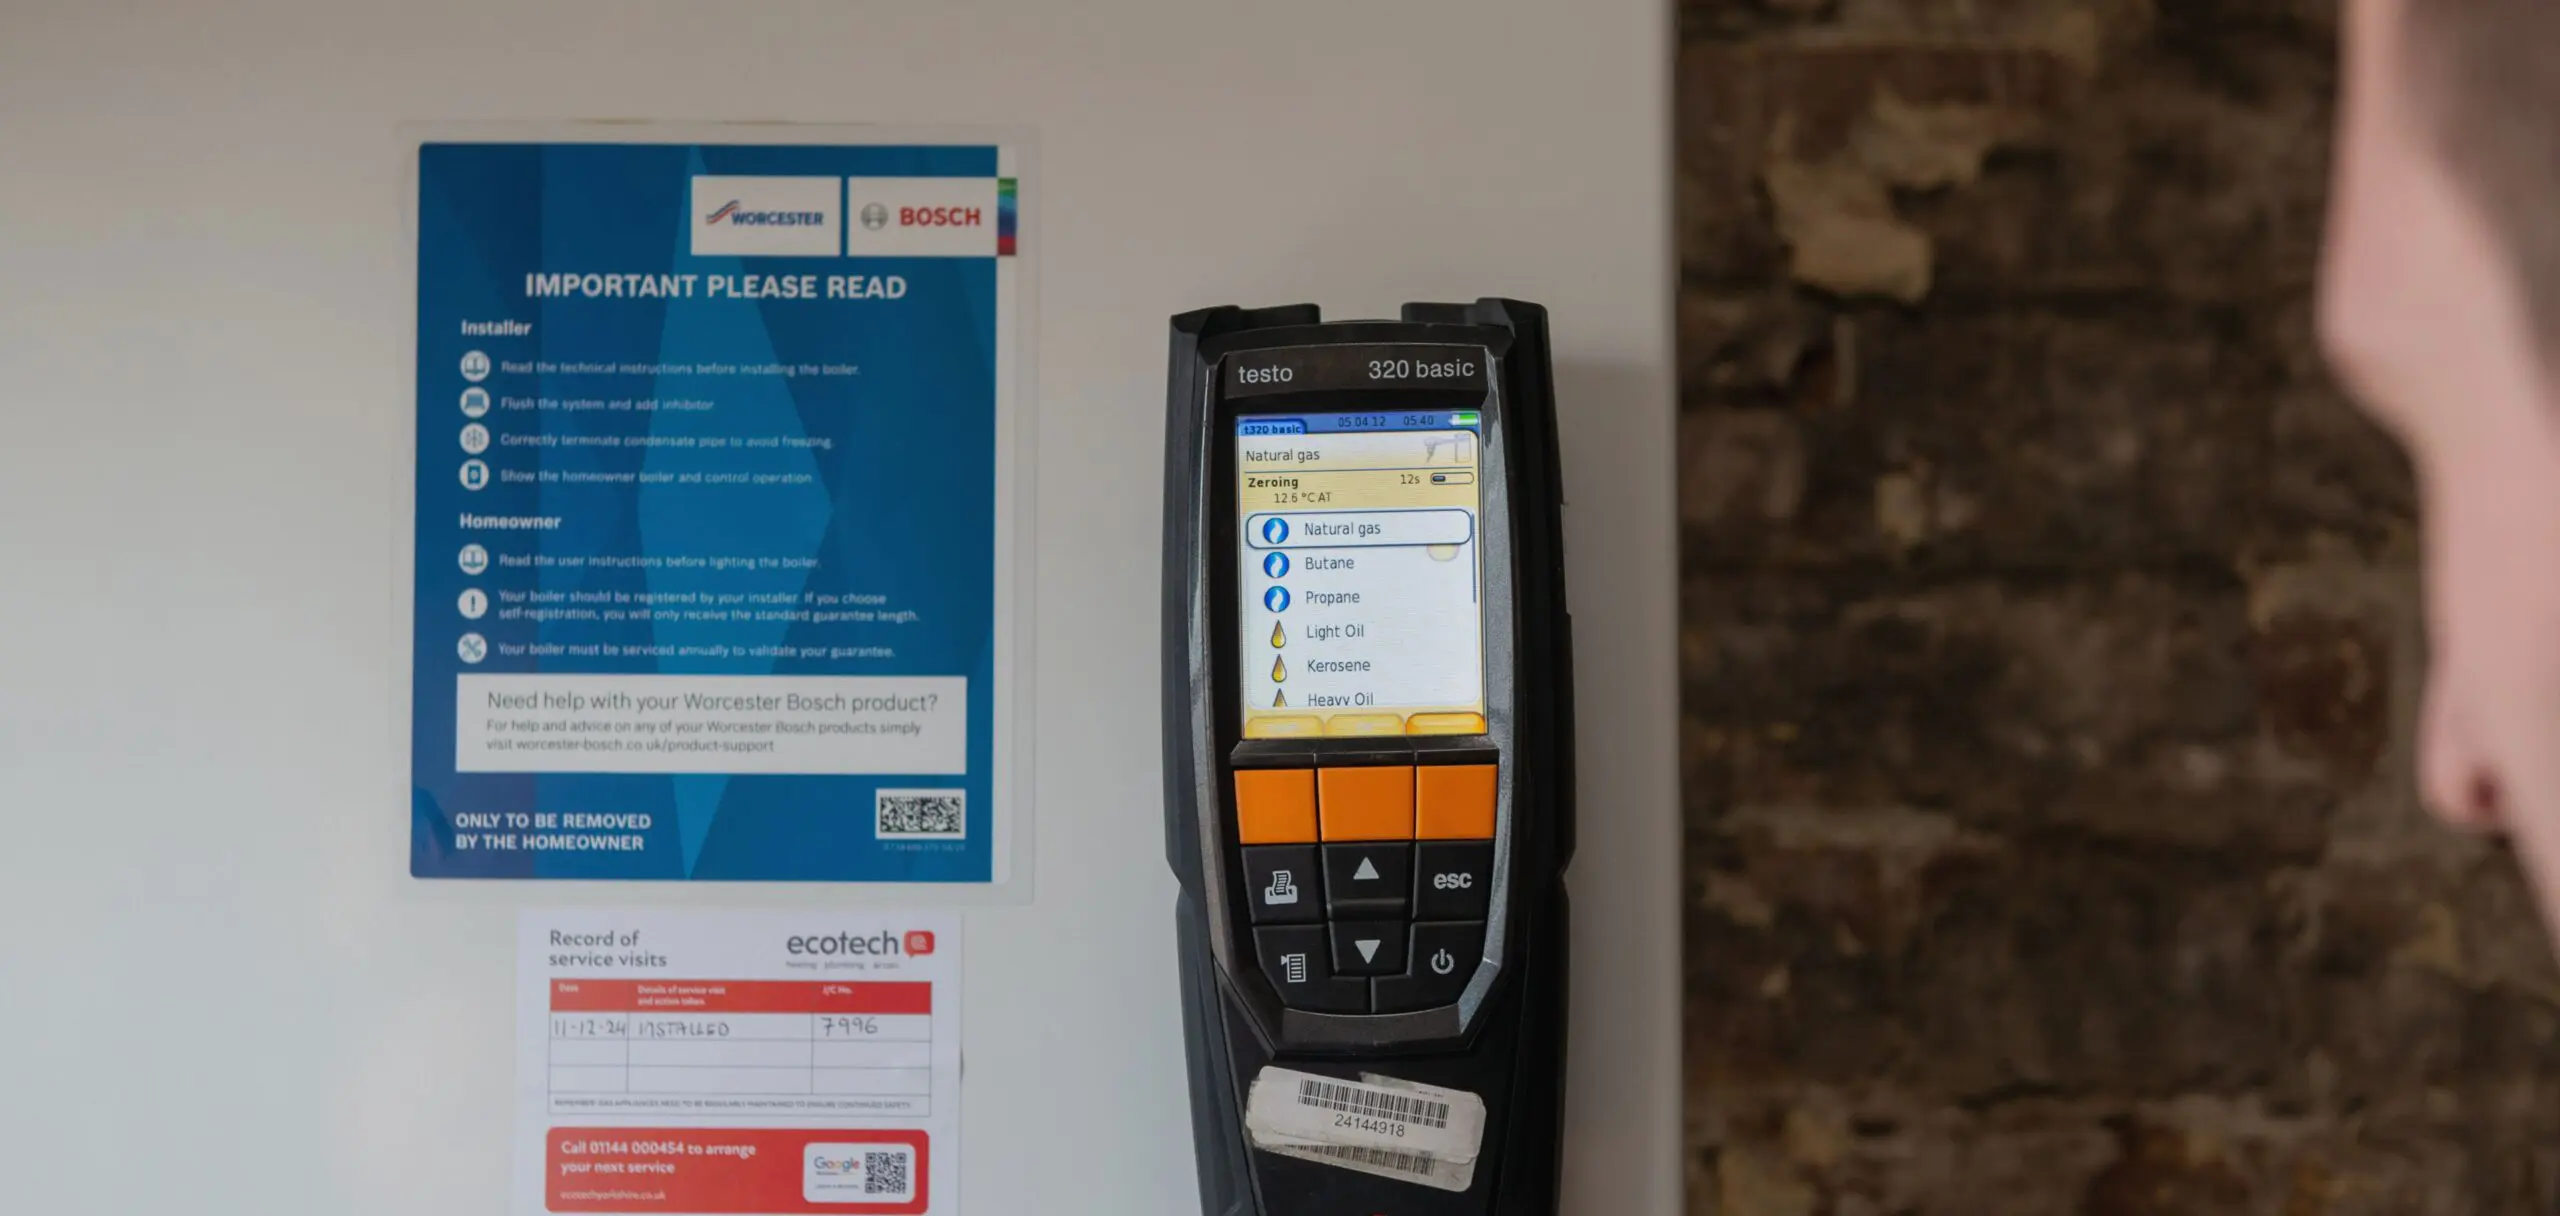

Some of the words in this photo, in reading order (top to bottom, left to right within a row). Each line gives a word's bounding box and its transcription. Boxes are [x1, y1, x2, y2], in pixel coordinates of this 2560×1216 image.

[732, 209, 824, 226] WORCESTER
[900, 208, 981, 226] BOSCH
[525, 272, 698, 298] IMPORTANT
[707, 274, 817, 298] PLEASE
[826, 276, 906, 298] READ
[462, 319, 532, 336] Installer
[502, 361, 532, 373] Read
[537, 362, 556, 373] the
[561, 363, 615, 373] technical
[620, 363, 692, 374] instructions
[697, 363, 736, 374] before
[741, 364, 794, 376] installing
[800, 365, 818, 375] the
[823, 364, 860, 375] boiler.
[1238, 365, 1292, 383] testo
[1368, 360, 1409, 378] 320
[1416, 359, 1474, 378] basic
[501, 397, 533, 409] Flush
[538, 398, 558, 409] the
[563, 399, 604, 412] system
[609, 399, 631, 410] and
[636, 399, 658, 410] add
[1244, 426, 1269, 434] t320
[1272, 425, 1301, 434] basic
[501, 433, 557, 447] Correctly
[562, 434, 620, 446] terminate
[624, 436, 694, 447] condensate
[699, 437, 725, 448] pipe
[731, 437, 742, 446] to
[747, 436, 778, 447] avoid
[783, 436, 835, 449] freezing.
[1246, 450, 1293, 462] Natural
[1298, 451, 1320, 464] gas
[501, 469, 535, 481] Show
[539, 471, 557, 481] the
[563, 470, 634, 482] homeowner
[639, 470, 673, 483] boiler
[679, 471, 700, 483] and
[705, 473, 748, 483] control
[753, 473, 811, 484] operation
[1248, 476, 1298, 488] Zeroing
[1400, 474, 1420, 484] 12s
[1274, 493, 1298, 503] 12.6
[460, 512, 561, 529] Homeowner
[1304, 523, 1354, 535] Natural
[1359, 523, 1380, 537] gas
[500, 554, 530, 566] Read
[535, 555, 554, 566] the
[558, 557, 584, 566] user
[589, 556, 661, 567] instructions
[667, 556, 705, 567] before
[710, 557, 754, 569] lighting
[759, 558, 778, 567] the
[1305, 557, 1354, 570] Butane
[499, 590, 526, 602] Your
[530, 590, 565, 602] boiler
[570, 591, 610, 602] should
[615, 592, 629, 602] be
[634, 592, 695, 605] registered
[700, 593, 713, 605] by
[718, 595, 744, 604] your
[805, 592, 813, 603] If
[818, 595, 838, 605] you
[843, 593, 886, 604] choose
[1306, 591, 1360, 606] Propane
[604, 610, 624, 621] you
[629, 609, 650, 620] will
[655, 610, 679, 621] only
[684, 612, 726, 621] receive
[731, 610, 751, 620] the
[755, 610, 809, 621] standard
[813, 613, 873, 623] guarantee
[878, 611, 920, 623] length.
[1307, 625, 1342, 640] Light
[1345, 624, 1364, 638] Oil
[499, 643, 525, 654] Your
[530, 643, 565, 655] boiler
[569, 644, 598, 655] must
[604, 644, 618, 655] be
[623, 645, 674, 656] serviced
[678, 645, 728, 658] annually
[733, 646, 745, 656] to
[750, 645, 797, 656] validate
[801, 648, 827, 658] your
[831, 647, 895, 658] guarantee.
[1307, 660, 1370, 673] Kerosene
[488, 692, 537, 708] Need
[544, 692, 585, 711] help
[590, 692, 631, 709] with
[636, 696, 678, 713] your
[684, 693, 781, 711] Worcester
[787, 693, 845, 711] Bosch
[852, 693, 938, 714] product?
[1354, 692, 1373, 706] Oil
[487, 720, 507, 731] For
[512, 720, 539, 733] help
[543, 720, 566, 731] and
[570, 720, 611, 732] advice
[615, 723, 630, 732] on
[634, 723, 655, 734] any
[660, 720, 672, 732] of
[676, 723, 702, 734] your
[708, 722, 771, 733] Worcester
[776, 722, 815, 733] Bosch
[819, 722, 876, 735] products
[880, 722, 920, 736] simply
[486, 738, 512, 749] visit
[456, 812, 500, 829] ONLY
[506, 814, 529, 828] TO
[535, 814, 558, 828] BE
[564, 814, 651, 828] REMOVED
[456, 834, 483, 850] BY
[484, 834, 518, 850] THE
[523, 834, 644, 850] HOMEOWNER
[1434, 871, 1472, 889] esc
[549, 930, 614, 947] Record
[620, 930, 639, 947] of
[787, 931, 899, 955] ecotech
[549, 953, 615, 967] service
[619, 951, 667, 967] visits
[554, 1020, 626, 1036] 11-12-24
[821, 1017, 878, 1036] 7996
[1335, 1114, 1405, 1137] 24144918
[562, 1142, 586, 1154] Call
[590, 1142, 628, 1154] 01144
[632, 1143, 684, 1155] 000454
[688, 1144, 702, 1155] to
[706, 1145, 756, 1159] arrange
[561, 1162, 592, 1175] your
[595, 1162, 624, 1173] next
[628, 1162, 675, 1174] service
[815, 1157, 860, 1172] Google
